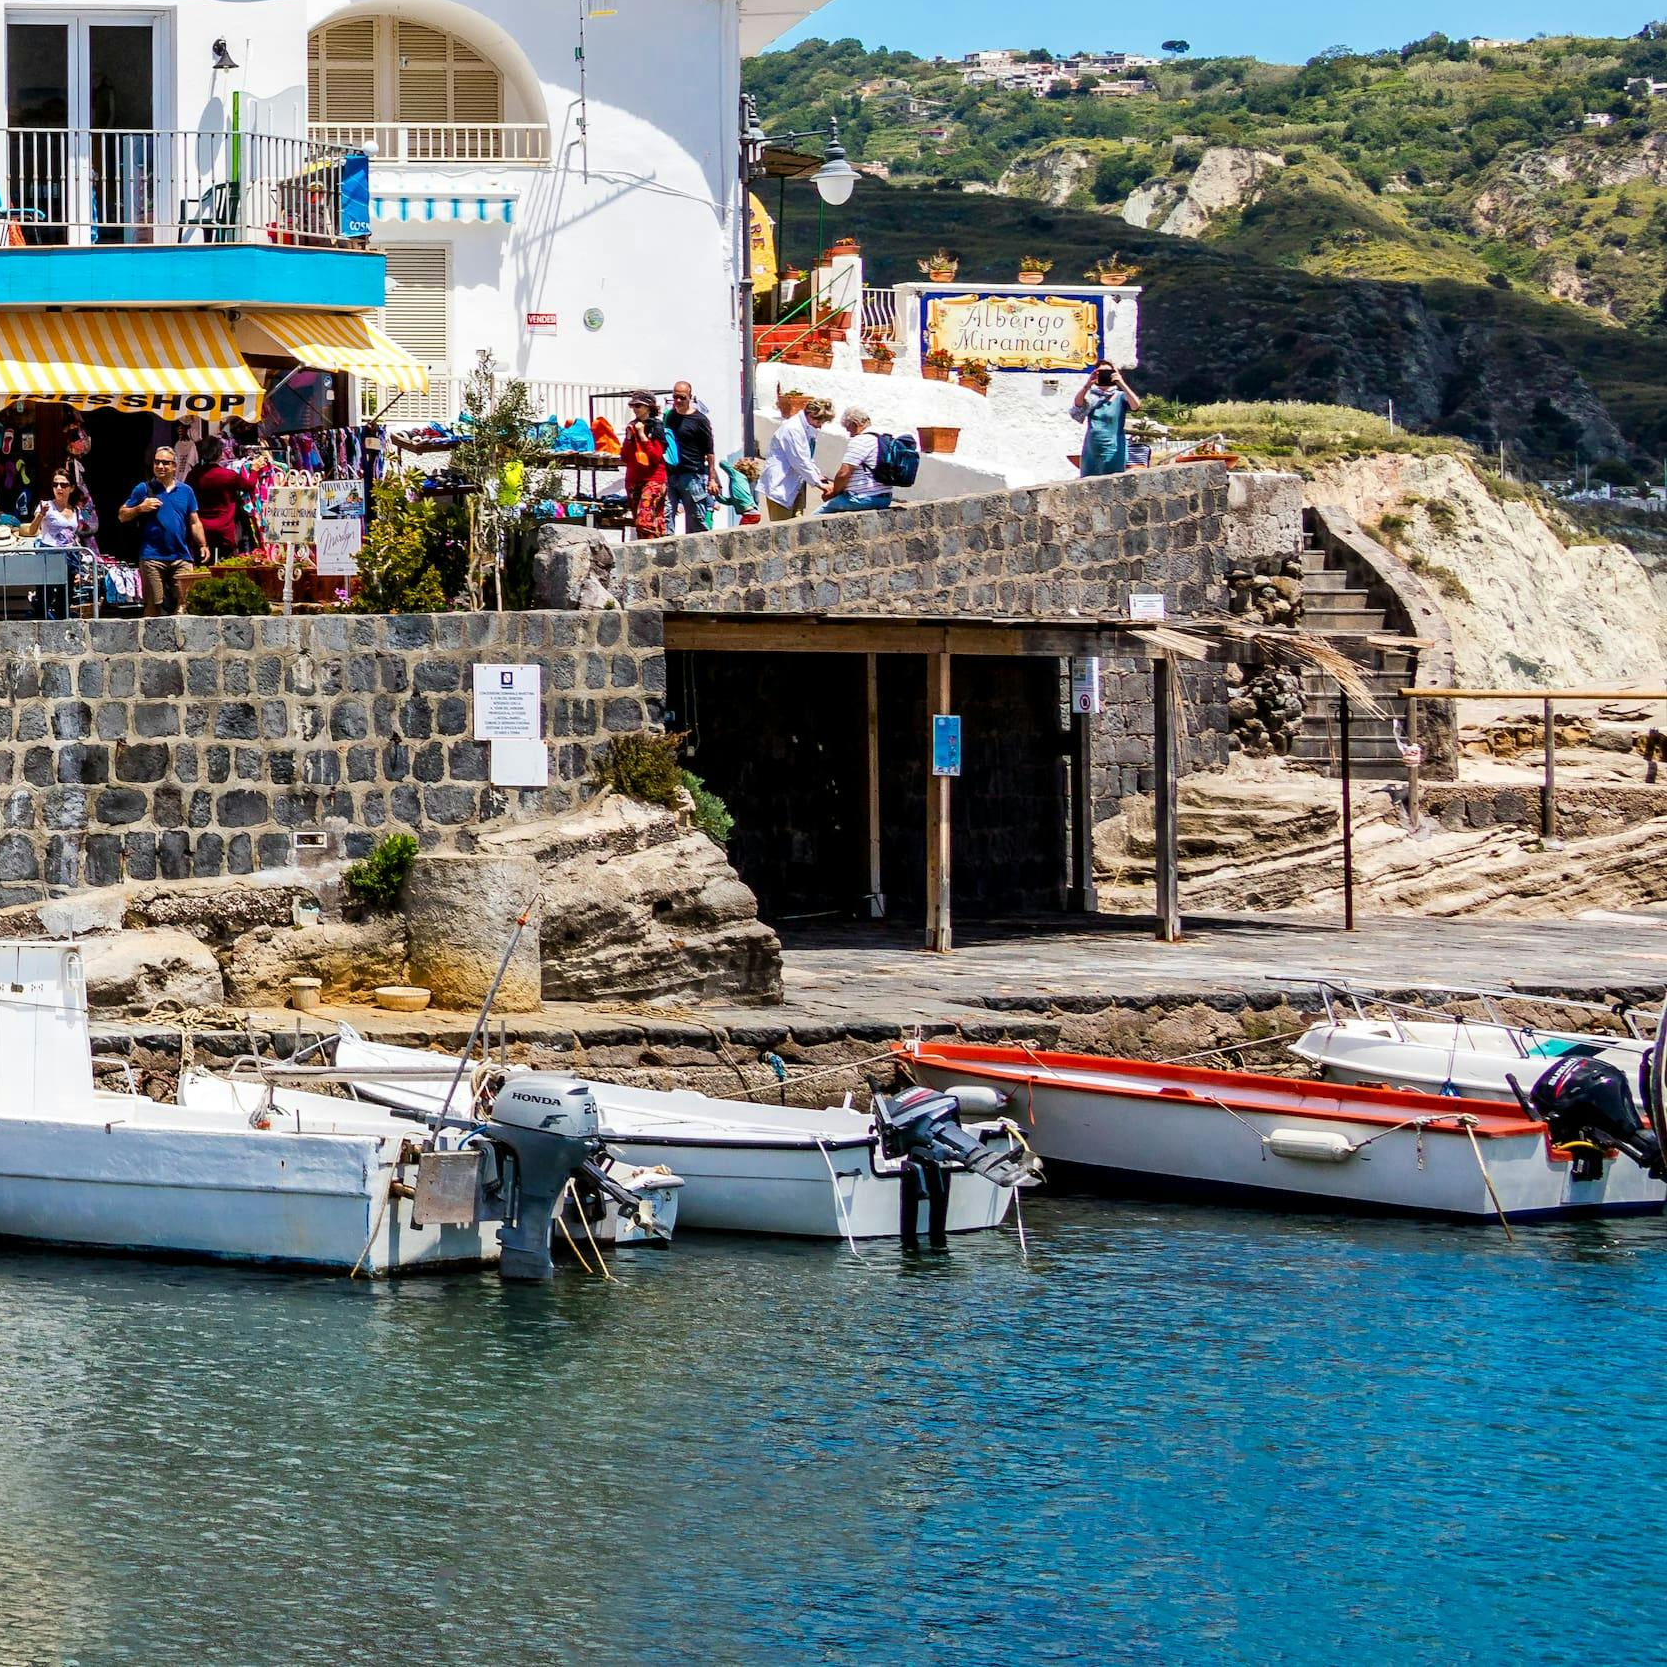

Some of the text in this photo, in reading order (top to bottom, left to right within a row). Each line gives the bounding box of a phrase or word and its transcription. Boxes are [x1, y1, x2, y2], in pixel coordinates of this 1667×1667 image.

[960, 304, 1065, 333] Albergo
[953, 329, 1071, 352] Miramare
[121, 394, 245, 412] SHOP
[512, 1092, 562, 1106] HONDA
[584, 1102, 598, 1114] 20
